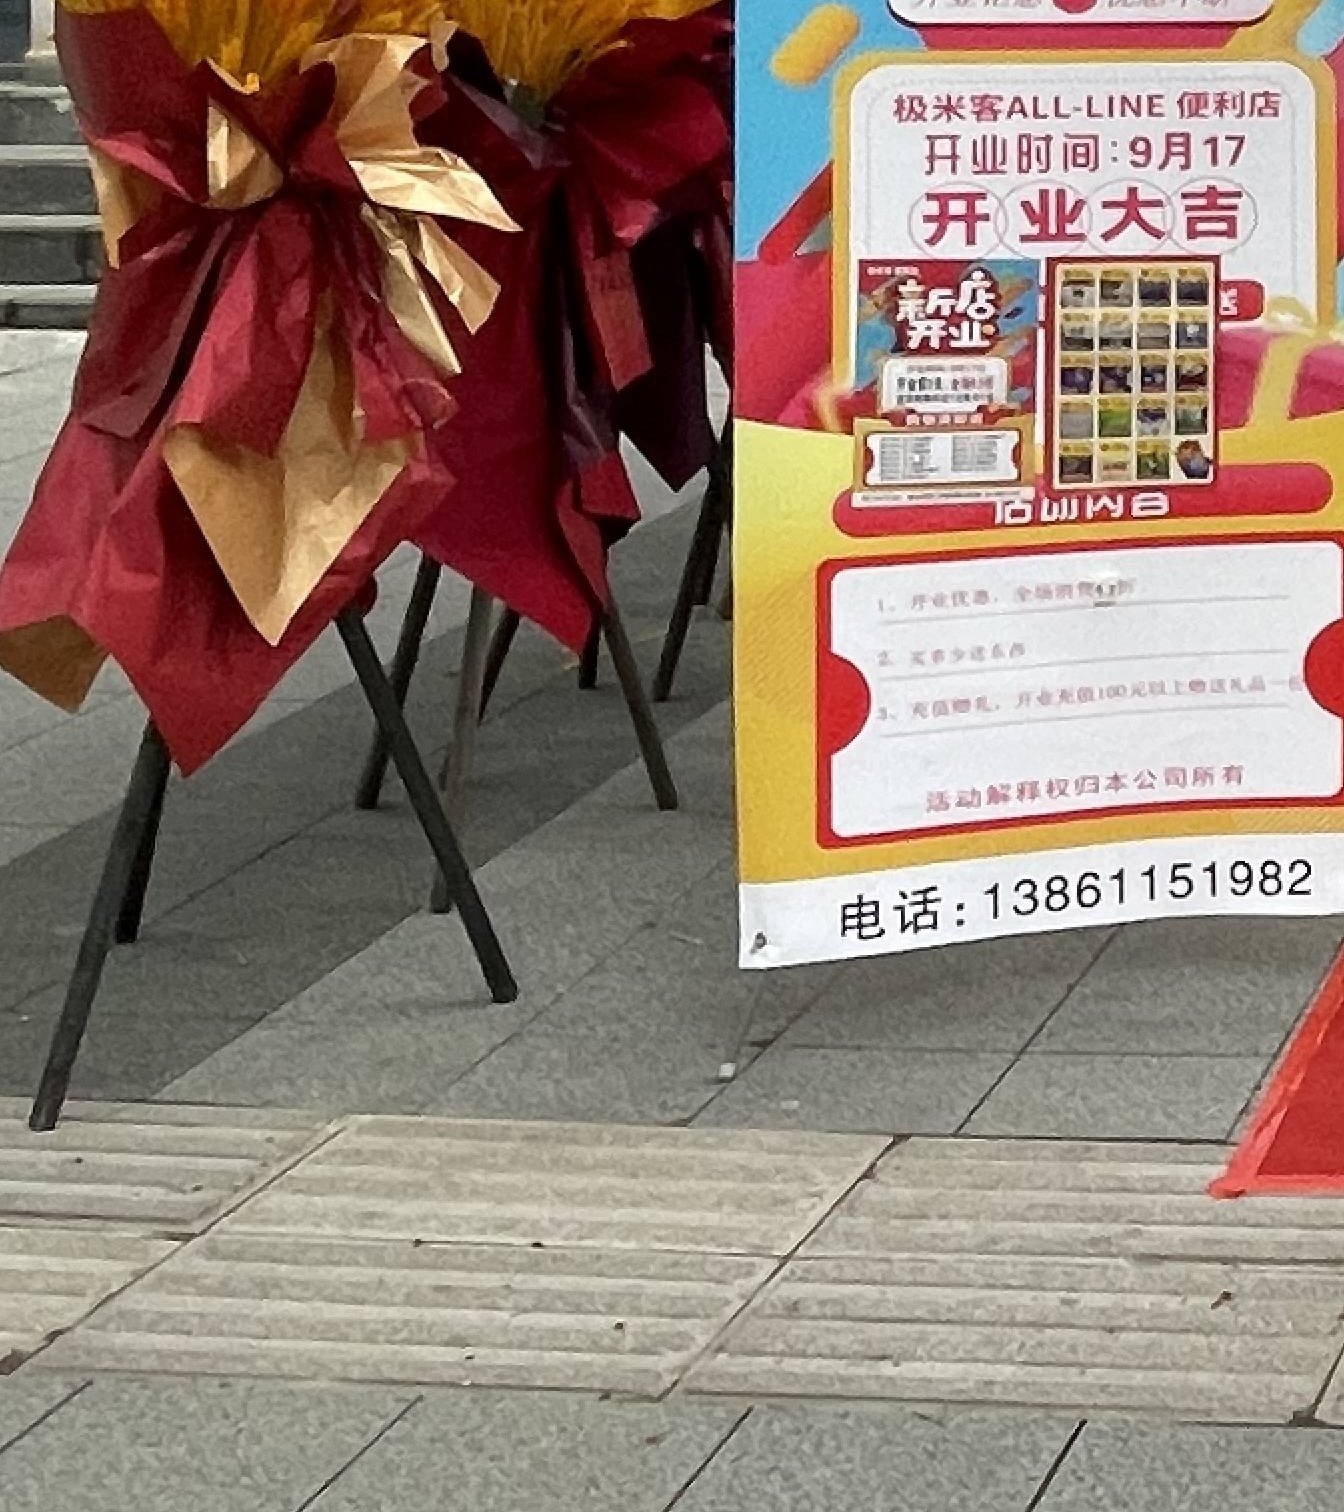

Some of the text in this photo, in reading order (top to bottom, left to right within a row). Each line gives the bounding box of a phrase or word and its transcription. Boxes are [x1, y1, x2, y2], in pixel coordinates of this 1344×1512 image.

[922, 185, 1244, 247] 开业大吉
[840, 858, 1313, 941] 电话：13861151982
